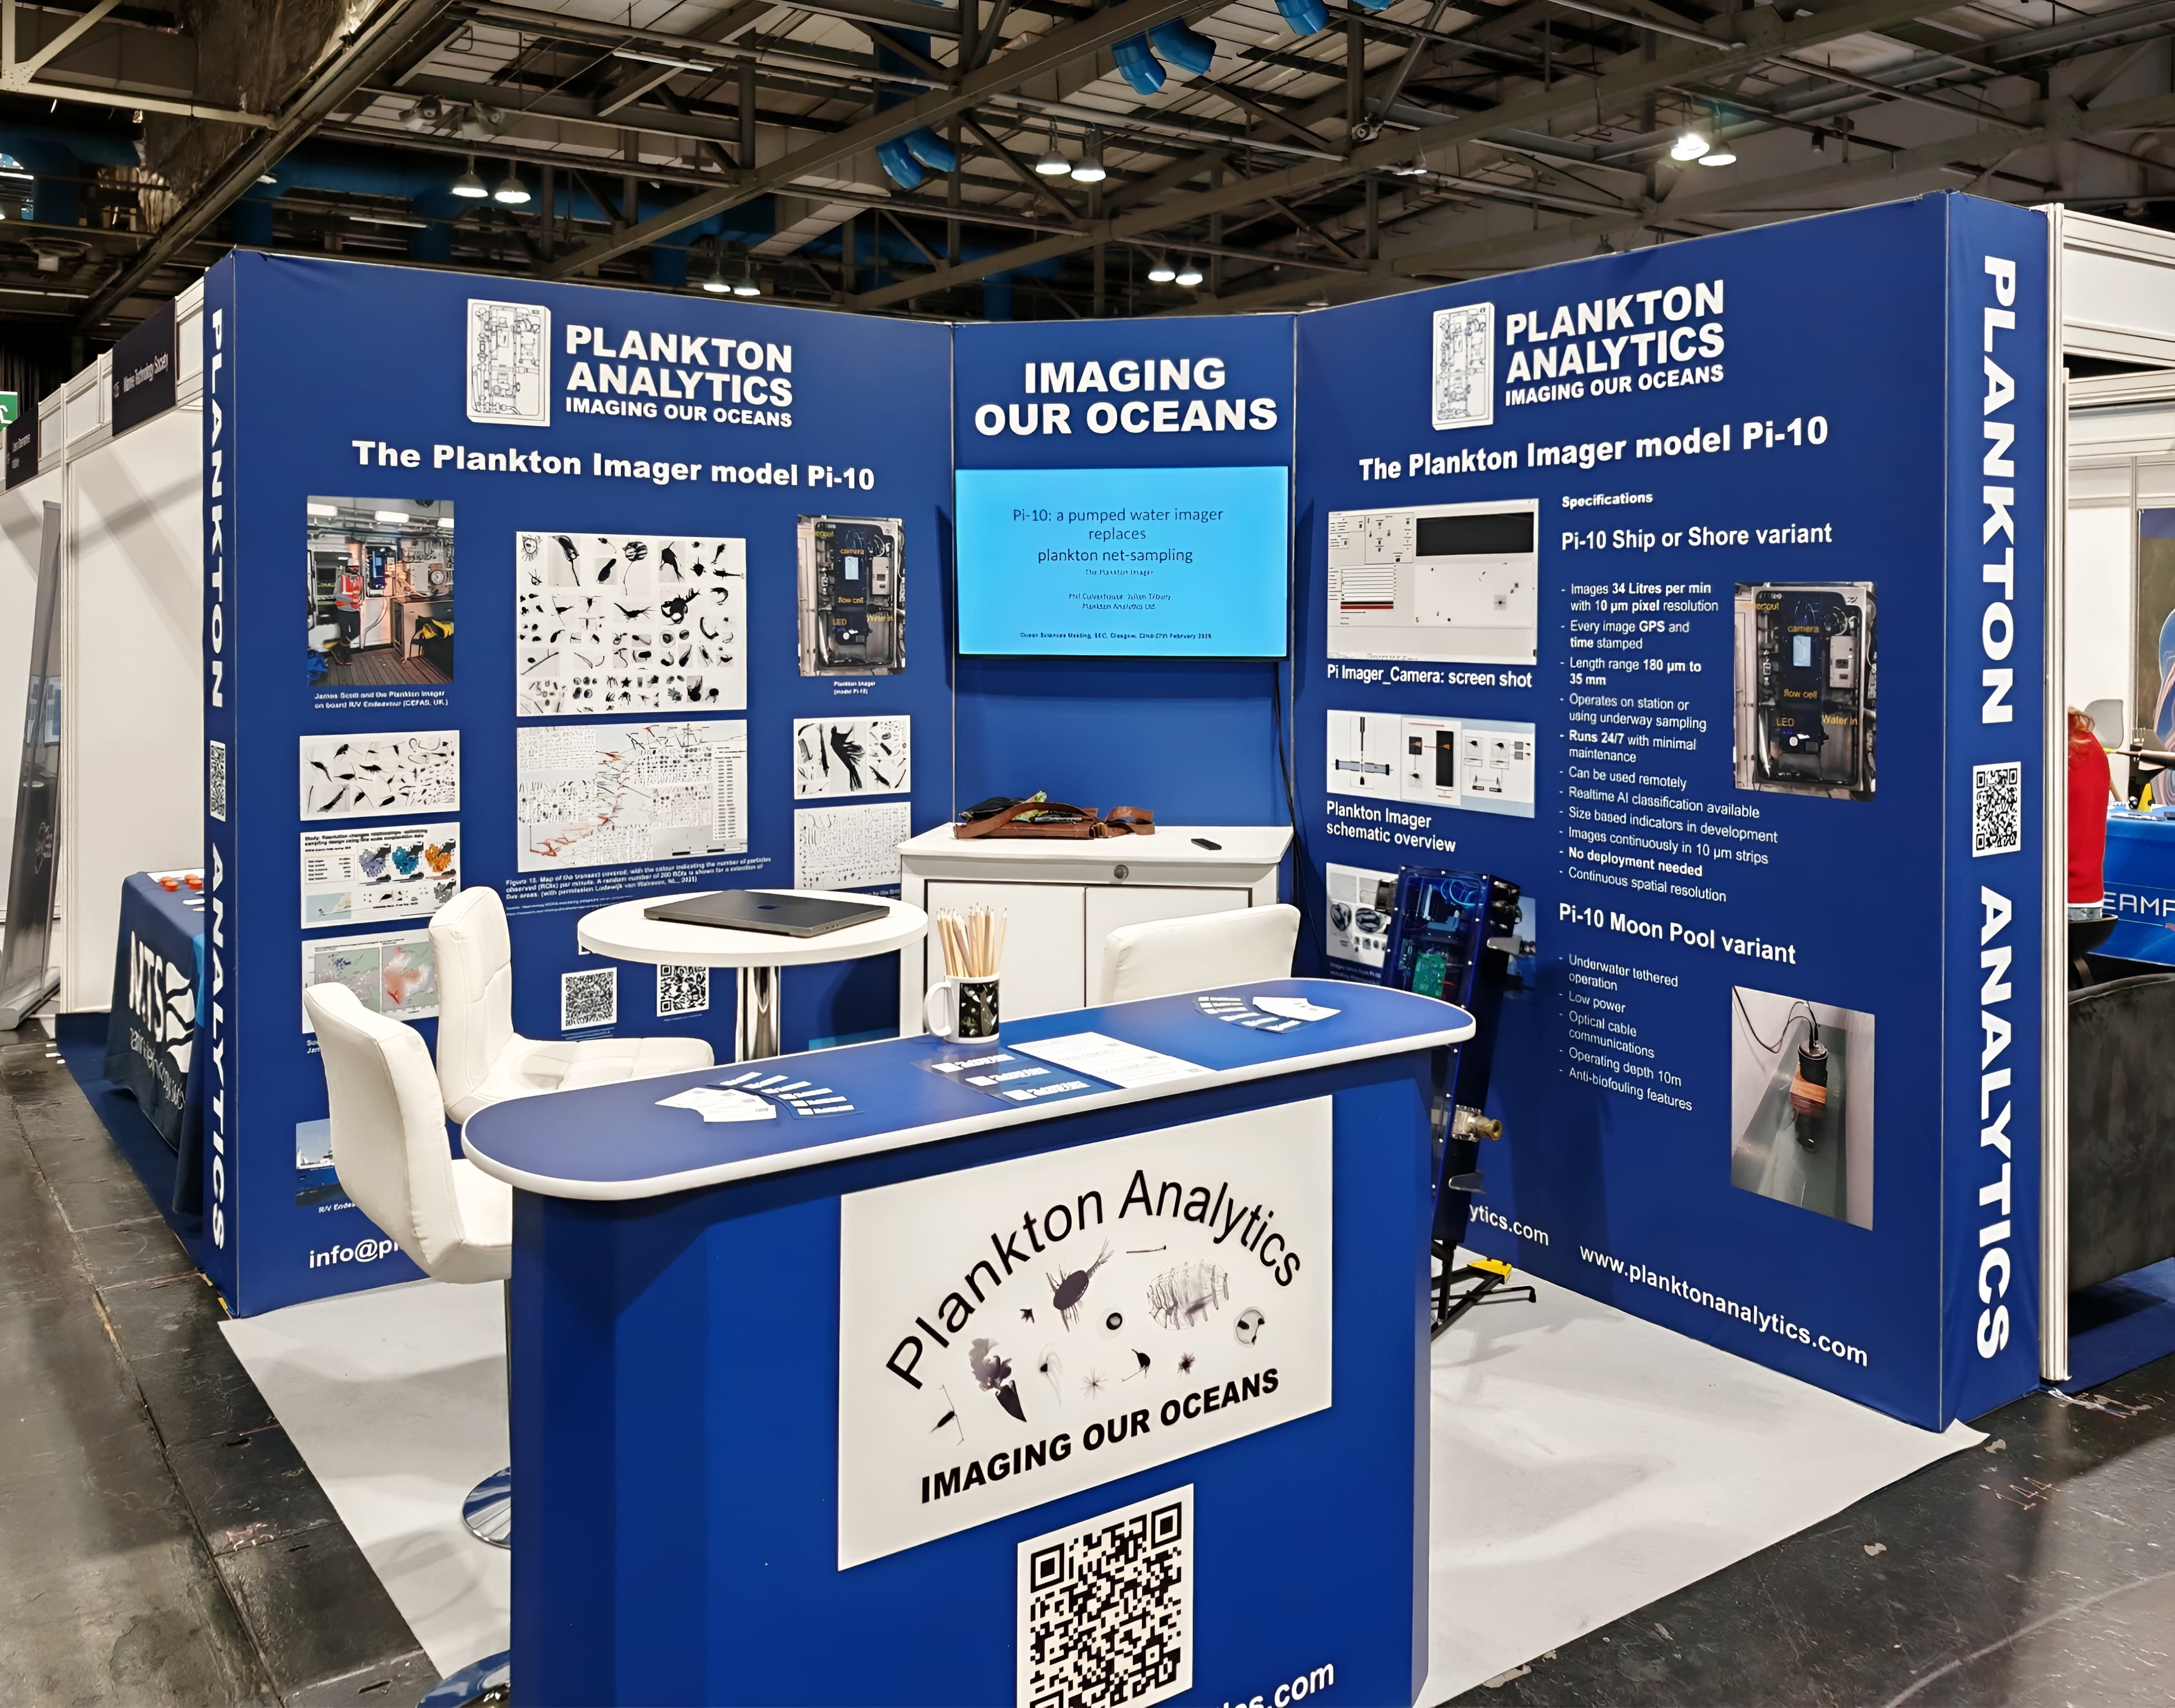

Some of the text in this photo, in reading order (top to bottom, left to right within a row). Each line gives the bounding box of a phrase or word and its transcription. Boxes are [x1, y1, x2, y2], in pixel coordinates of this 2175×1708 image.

[1507, 279, 1724, 346] PLANKTON
[567, 324, 792, 373] PLANKTON
[1506, 322, 1725, 384] ANALYTICS
[567, 361, 793, 407] ANALYTICS
[1025, 358, 1225, 394] IMAGING
[1506, 364, 1724, 406] IMAGING OUR OCEANS
[566, 397, 792, 428] IMAGING OUR OCEANS
[975, 398, 1278, 436] OUR OCEANS
[1359, 416, 1828, 481] The Plankton Imager model Pi-10
[352, 440, 875, 490] The Plankton Imager model Pi-10
[1014, 508, 1224, 524] Pi-10: a pumped water imager
[1562, 492, 1653, 510] Specifications
[1089, 527, 1146, 542] replaces
[1562, 523, 1832, 553] Pi-10 Ship or Shore variant
[1038, 548, 1193, 564] plankton net-sampling
[1571, 582, 1711, 597] Images 34 Litres per min
[1571, 600, 1591, 611] with
[1595, 599, 1607, 611] 10
[1632, 599, 1660, 614] pixel
[1663, 599, 1719, 612] resolution
[1571, 619, 1690, 635] Every image GPS and
[1570, 636, 1643, 651] time stamped
[1328, 664, 1532, 688] Pi Imager_Camera: screen shot
[1570, 656, 1605, 671] Length
[1608, 660, 1640, 673] range
[1643, 658, 1663, 671] 180
[1689, 661, 1701, 672] to
[1570, 673, 1606, 686] 35 mm
[1569, 692, 1690, 711] Operates on station or
[1569, 711, 1706, 733] using underway sampling
[1569, 729, 1696, 751] Runs 24/7 with minimal
[1569, 747, 1636, 763] maintenance
[212, 309, 224, 1249] PLANKTON ANALYTICS
[1568, 766, 1687, 792] Can be used remotely
[1327, 800, 1432, 829] Plankton Imager
[1569, 786, 1760, 818] Realtime AI classification available
[1977, 256, 2015, 1358] PLANKTON ANALYTICS
[1327, 822, 1456, 852] schematic overview
[1568, 806, 1778, 843] Size based indicators in development
[1569, 826, 1607, 843] Images
[1610, 834, 1679, 855] continuously
[1682, 841, 1692, 853] in
[1696, 843, 1710, 856] 10
[1735, 850, 1769, 866] strips
[1569, 846, 1702, 877] No deployment needed
[1568, 866, 1726, 902] Continuous spatial resolution
[1560, 902, 1796, 965] Pi-10 Moon Pool variant
[1569, 954, 1678, 987] Underwater tethered
[1569, 973, 1617, 991] operation
[1569, 991, 1626, 1013] Low power
[1569, 1010, 1637, 1037] Optical cable
[1569, 1029, 1655, 1059] communications
[1569, 1047, 1681, 1087] Operating depth 10m
[1569, 1067, 1692, 1111] Anti-biofouling features
[1469, 1204, 1548, 1246] ytics.com
[886, 1170, 1300, 1389] Plankton Analytics
[1580, 1245, 1868, 1367] www.planktonanalytics.com
[922, 1368, 1279, 1504] IMAGING OUR OCEANS
